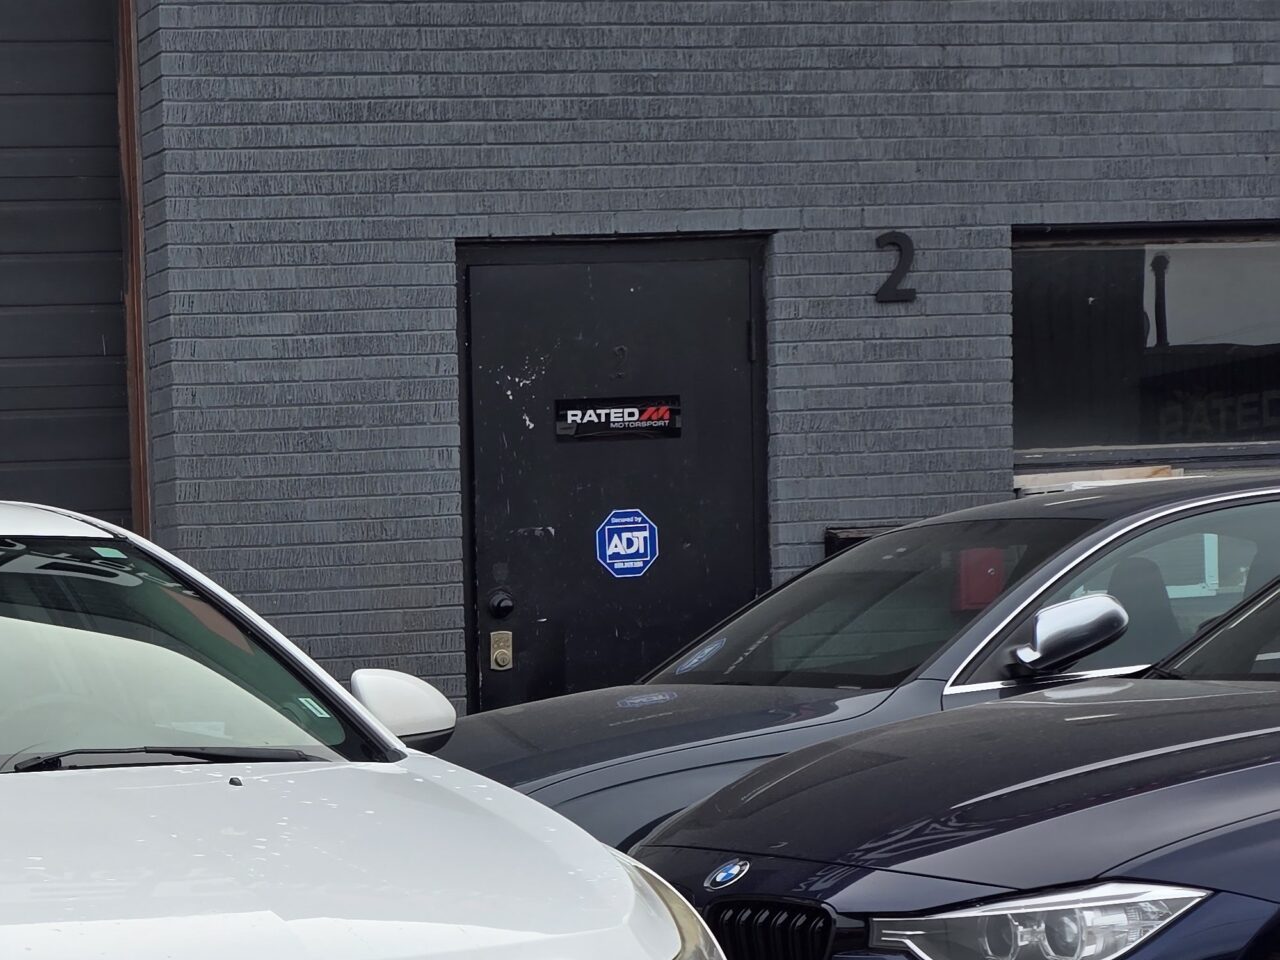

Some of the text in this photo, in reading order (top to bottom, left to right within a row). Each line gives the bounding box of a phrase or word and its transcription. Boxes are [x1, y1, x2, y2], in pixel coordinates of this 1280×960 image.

[875, 230, 917, 303] 2
[567, 408, 639, 424] RATED
[610, 420, 670, 428] MOTORSPORT
[608, 531, 648, 556] ADT
